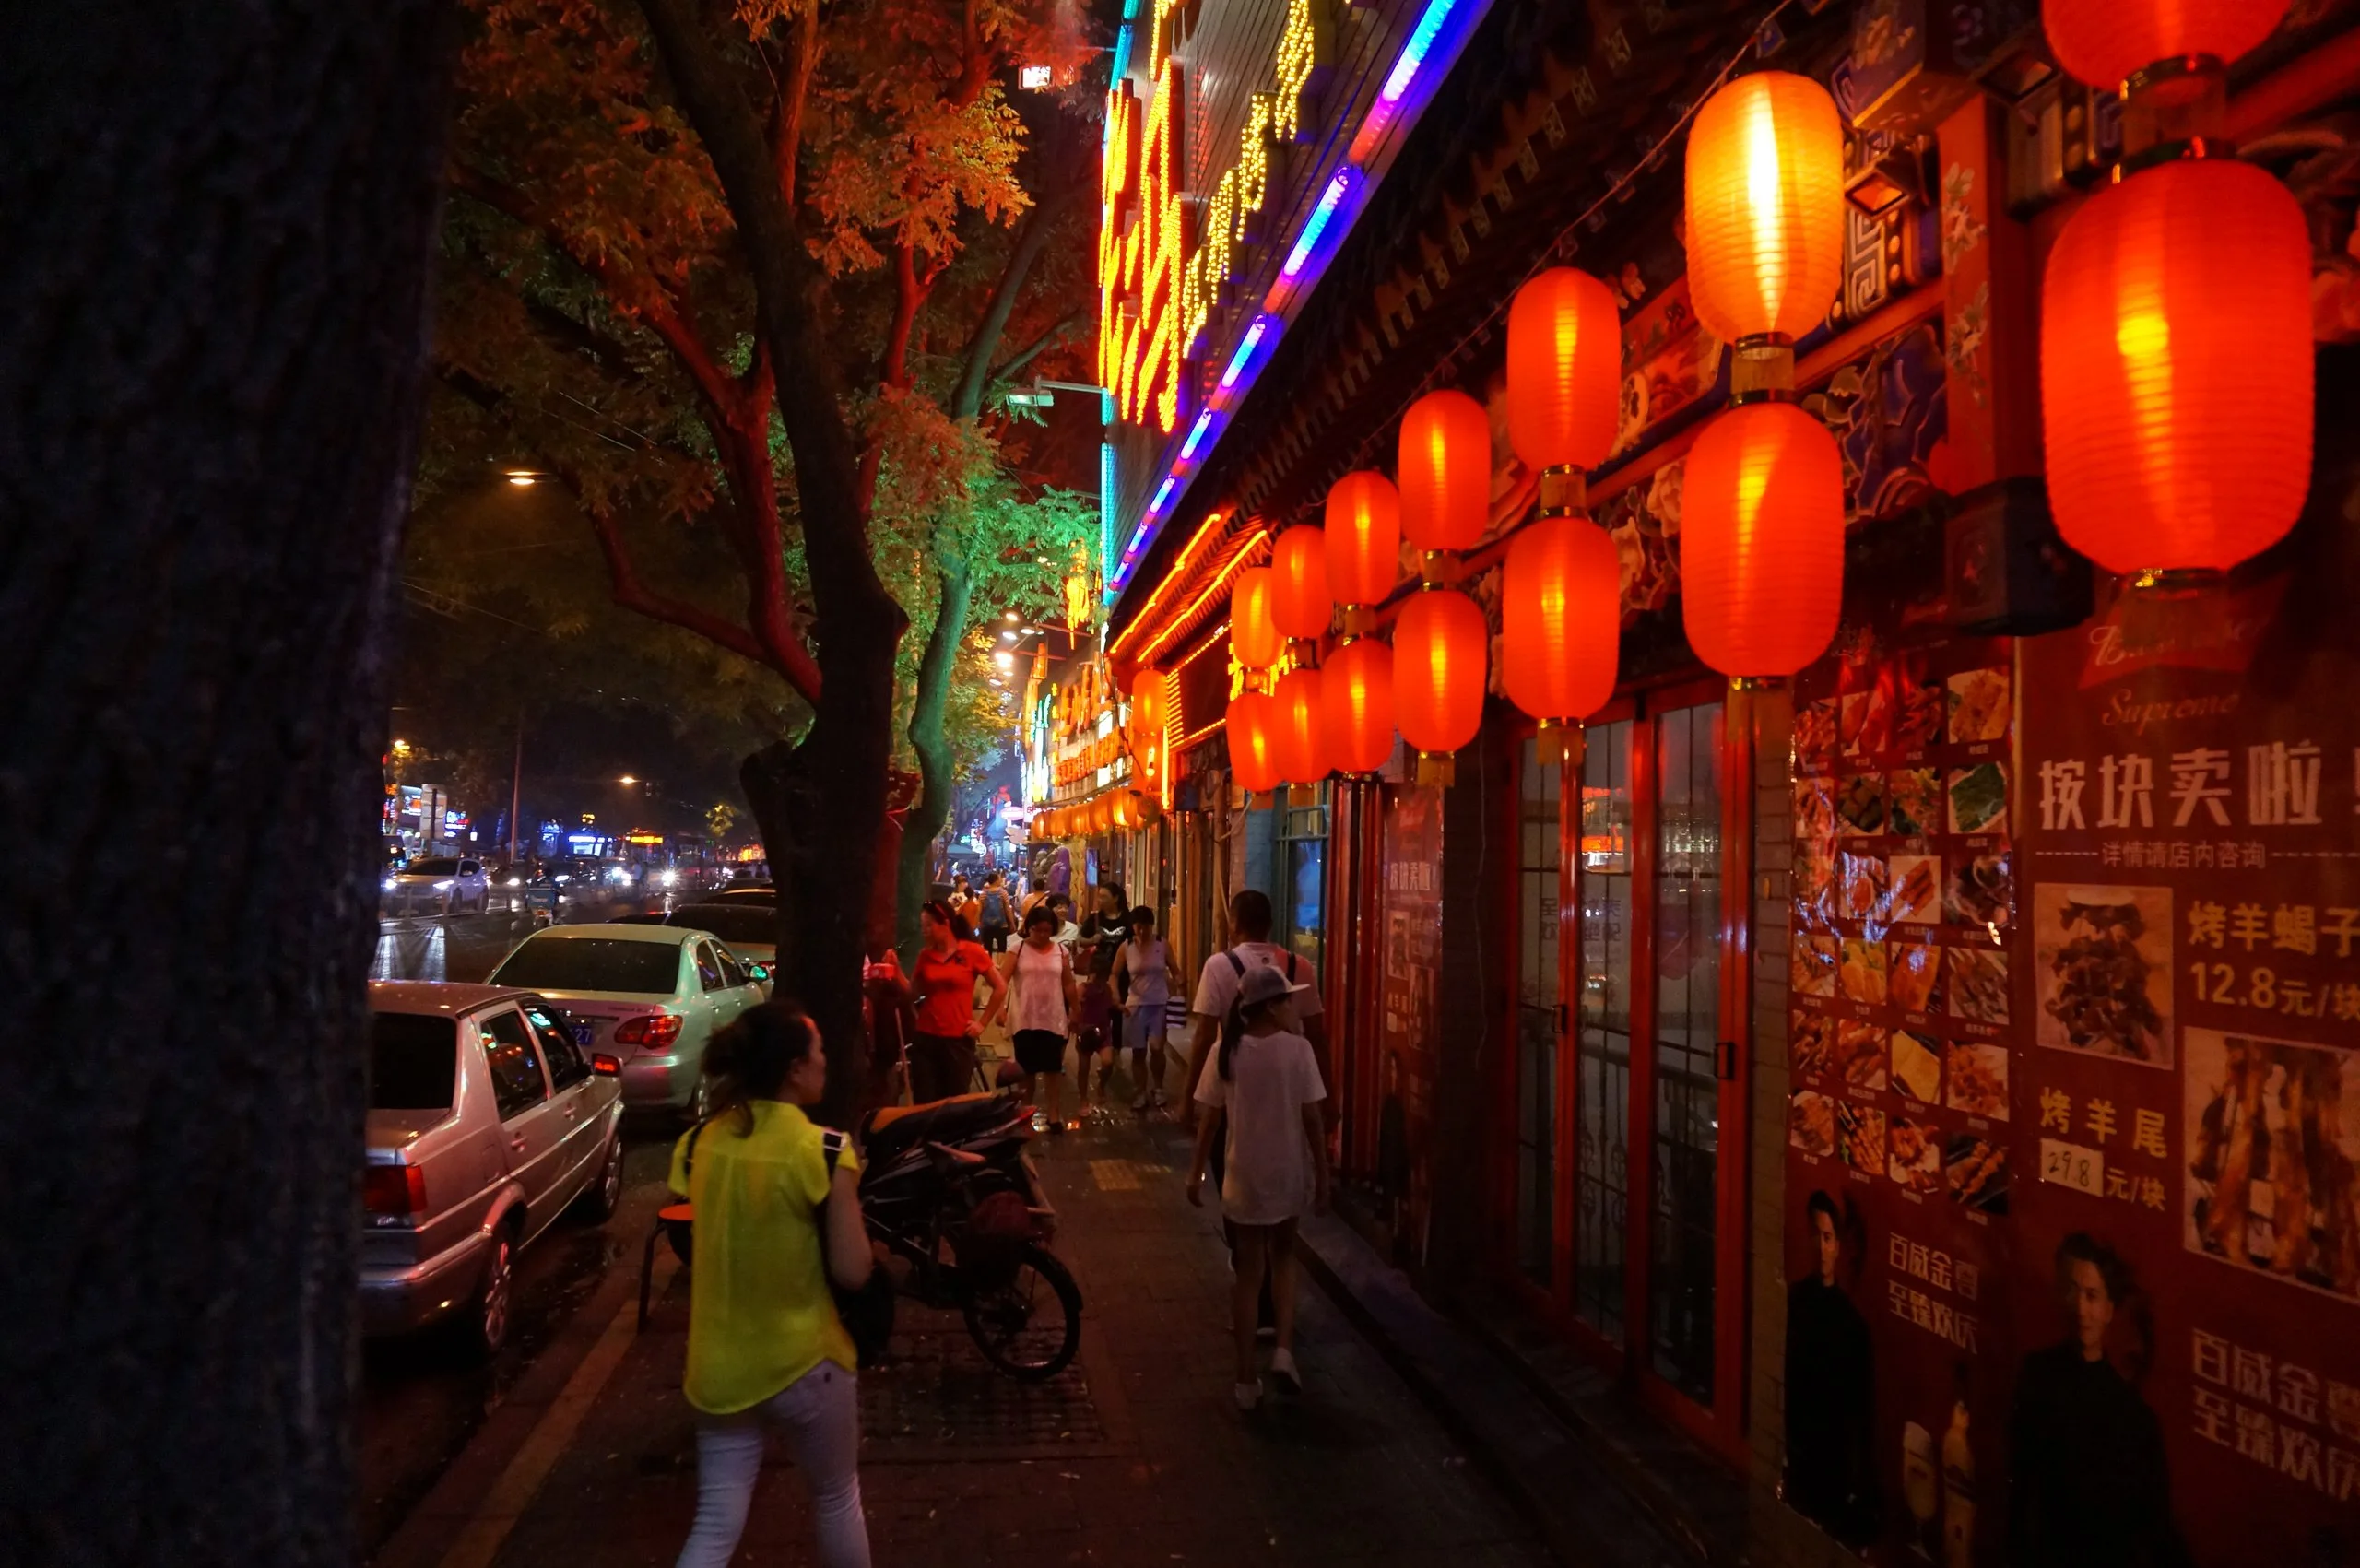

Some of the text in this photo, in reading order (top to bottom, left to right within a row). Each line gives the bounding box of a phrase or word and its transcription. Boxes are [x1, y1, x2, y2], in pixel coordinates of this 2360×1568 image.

[2102, 839, 2266, 869] 详情请店内咨询
[2189, 900, 2360, 957] 烤羊蝎子
[2040, 1087, 2167, 1158] 烤羊尾
[1889, 1232, 1979, 1302] 百威金尊
